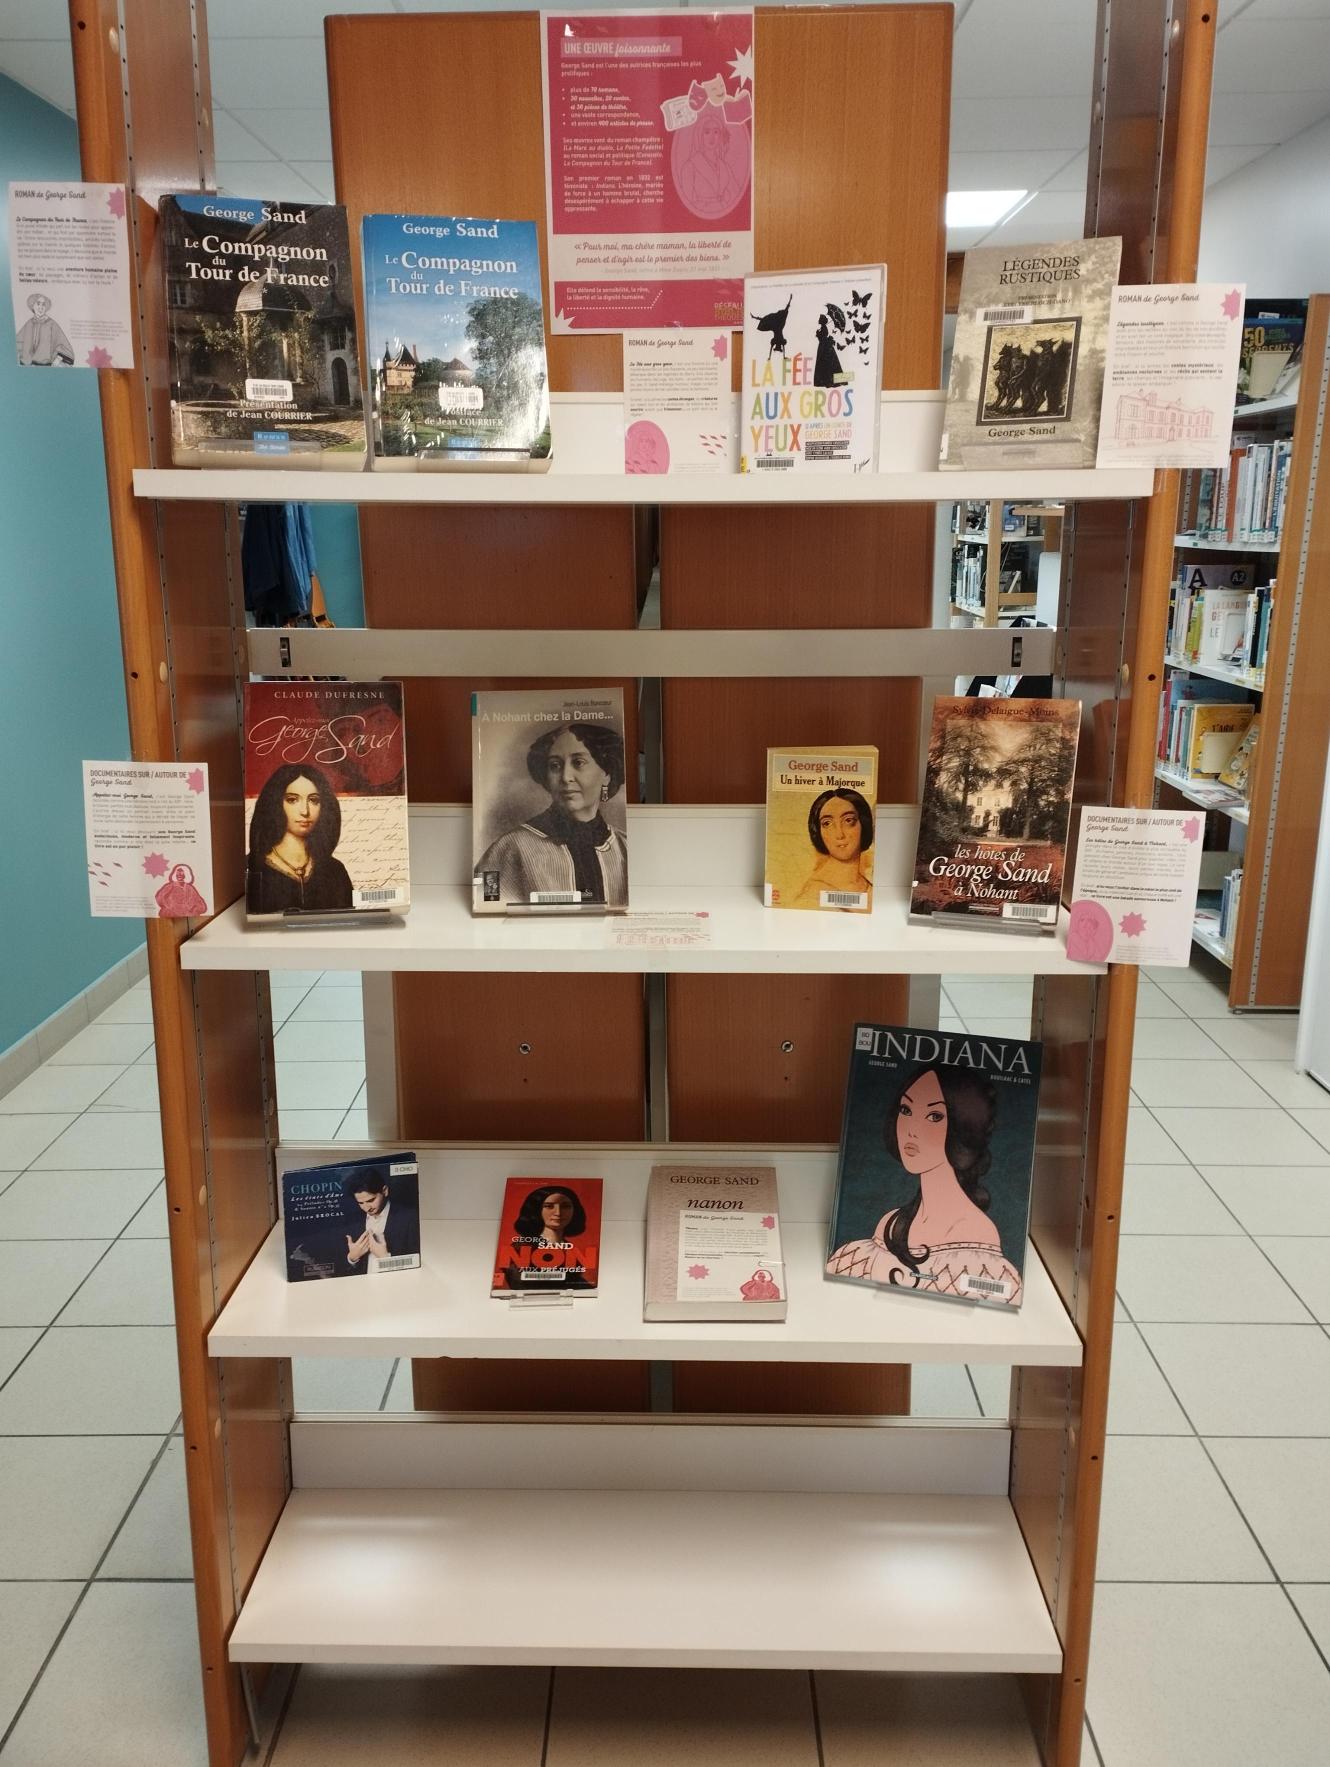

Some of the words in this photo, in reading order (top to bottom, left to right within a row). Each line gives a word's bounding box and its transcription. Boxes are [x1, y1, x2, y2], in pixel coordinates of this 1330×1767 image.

[564, 42, 581, 54] UNE
[583, 42, 614, 54] ŒUVRE
[614, 42, 671, 57] foisonnante
[15, 190, 35, 199] ROMAN
[45, 191, 67, 200] George
[69, 190, 86, 198] Sand
[203, 205, 254, 222] George
[260, 207, 306, 224] Sand
[403, 223, 450, 237] George
[456, 223, 499, 238] Sand
[184, 238, 199, 249] Le
[202, 235, 328, 265] Compagnon
[583, 242, 602, 250] Pour
[635, 241, 654, 250] chère
[656, 242, 687, 251] maman,
[688, 241, 696, 249] la
[697, 240, 722, 249] liberté
[212, 256, 226, 266] du
[385, 254, 398, 265] Le
[401, 252, 518, 275] Compagnon
[576, 256, 601, 265] penser
[634, 255, 646, 263] est
[654, 255, 684, 264] premier
[685, 253, 698, 262] des
[1003, 256, 1080, 272] LÉGENDES
[186, 262, 233, 281] Tour
[238, 265, 260, 283] de
[266, 267, 329, 287] France
[410, 271, 423, 281] du
[1000, 269, 1081, 285] RUSTIQUES
[386, 277, 429, 294] Tour
[434, 279, 454, 296] de
[459, 280, 519, 298] France
[1118, 294, 1143, 304] ROMAN
[1143, 295, 1151, 303] de
[1153, 294, 1179, 304] George
[1181, 293, 1199, 301] Sand
[657, 340, 676, 348] George
[1244, 327, 1265, 348] 50
[752, 358, 775, 388] LA
[782, 352, 813, 386] FÉE
[240, 400, 298, 409] Présentation
[751, 391, 792, 420] AUX
[800, 389, 854, 418] GROS
[226, 410, 237, 418] de
[240, 411, 262, 419] Jean
[264, 411, 312, 420] COURRIER
[437, 418, 457, 426] Jean
[751, 424, 801, 453] YEUX
[988, 427, 1026, 439] George
[1029, 426, 1056, 435] Sand
[1232, 572, 1246, 580] A2
[274, 691, 321, 699] CLAUDE
[325, 691, 385, 699] DUFRESNE
[493, 712, 531, 721] Nohant
[533, 712, 559, 721] chez
[561, 712, 571, 720] la
[574, 711, 614, 720] Dame...
[249, 715, 328, 763] George
[315, 714, 399, 764] Sand
[788, 760, 828, 773] George
[830, 761, 858, 772] Sand
[90, 770, 137, 778] DOCUMENTAIRES
[90, 778, 113, 787] George
[780, 775, 793, 785] Un
[794, 775, 816, 786] hiver
[819, 776, 824, 785] à
[826, 776, 865, 788] Majorque
[1087, 815, 1135, 825] DOCUMENTAIRES
[1136, 818, 1148, 826] SUR
[1086, 824, 1109, 833] George
[954, 845, 970, 859] les
[974, 845, 1007, 861] hôtes
[1009, 847, 1025, 862] de
[929, 856, 993, 883] George
[998, 861, 1053, 884] Sand
[954, 883, 963, 896] à
[967, 883, 1019, 900] Nohant
[869, 1030, 1032, 1075] INDIANA
[670, 1175, 720, 1185] GEORGE
[725, 1176, 759, 1186] SAND
[291, 1181, 343, 1194] CHOPIN
[687, 1199, 744, 1210] nanon
[538, 1242, 574, 1250] SAND
[500, 1245, 597, 1269] NON
